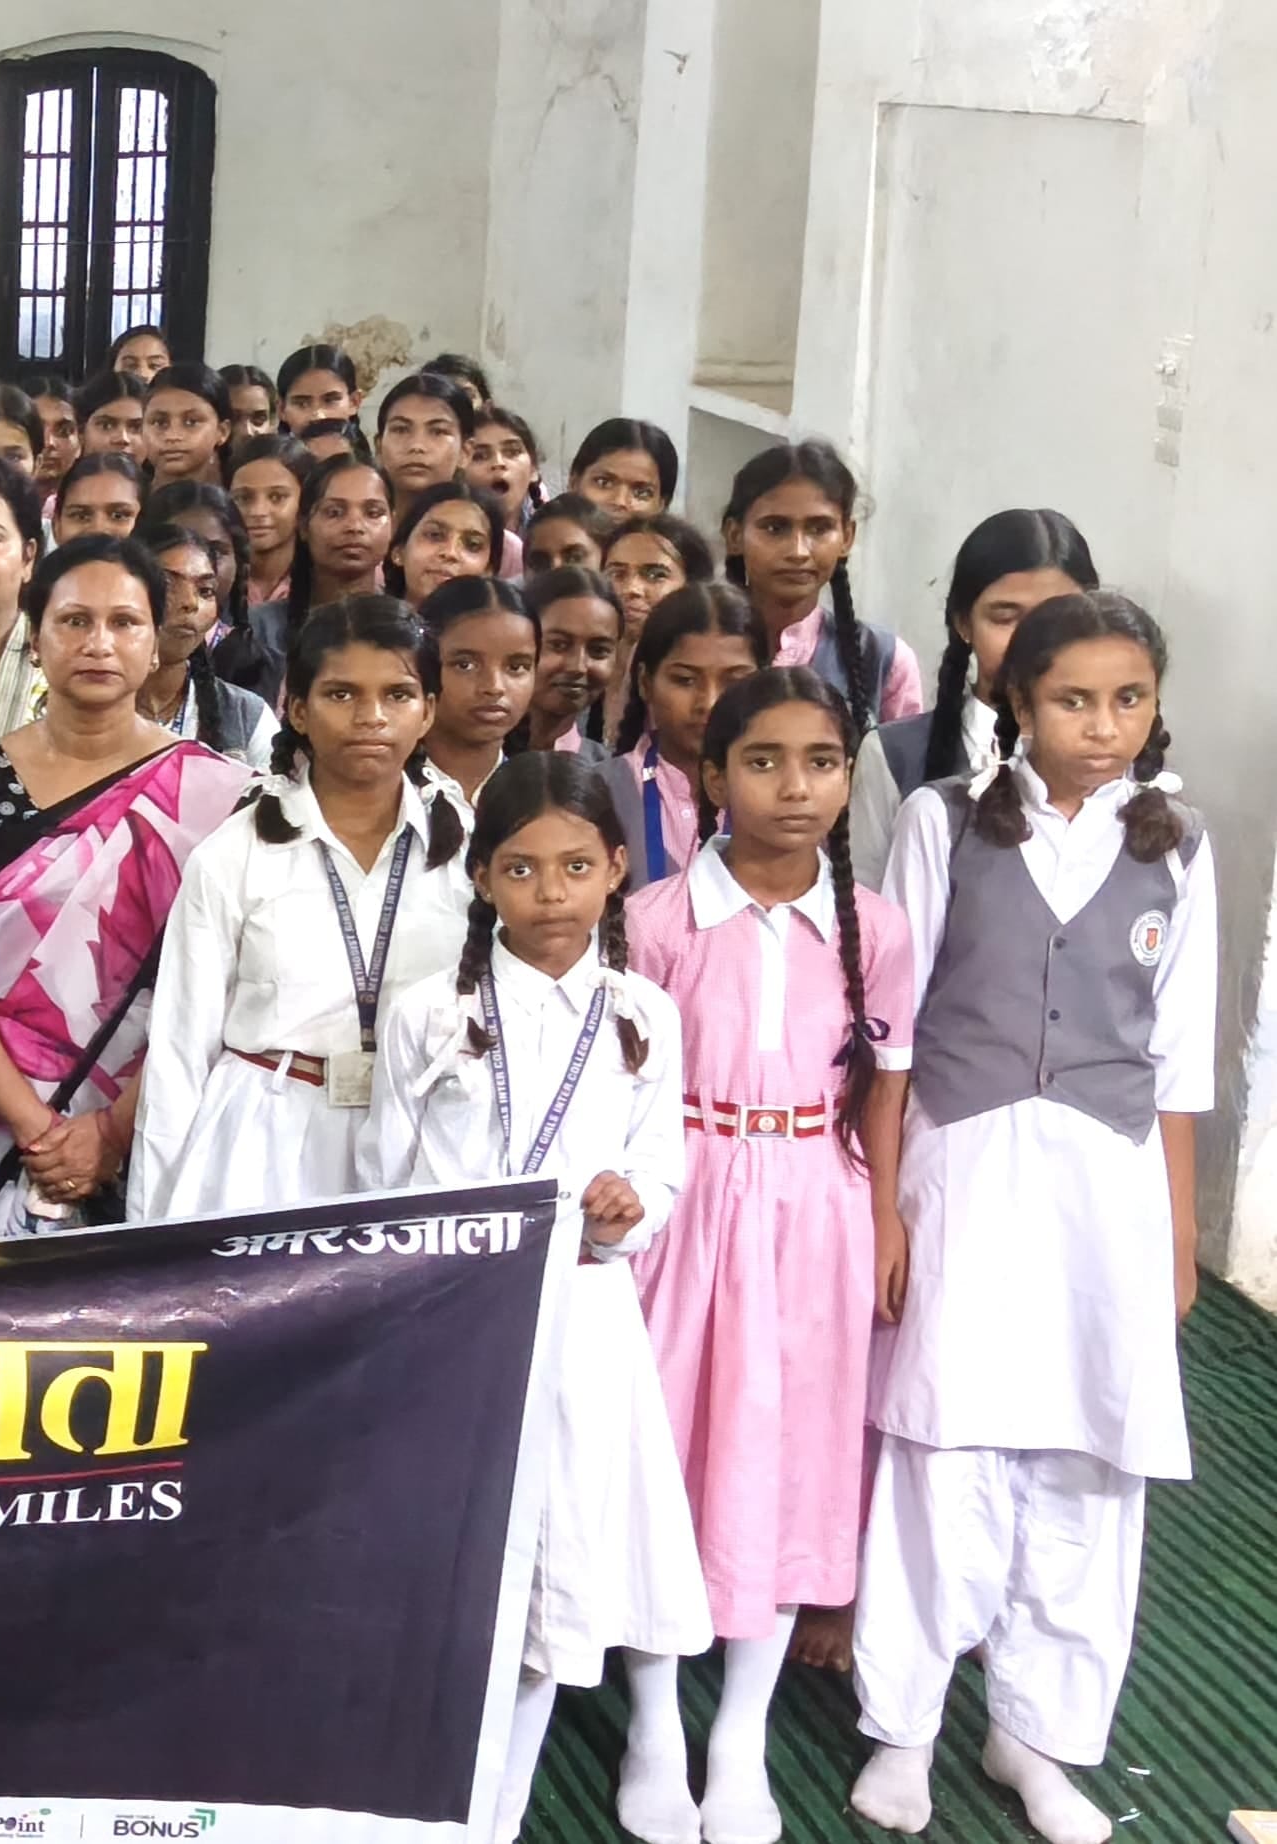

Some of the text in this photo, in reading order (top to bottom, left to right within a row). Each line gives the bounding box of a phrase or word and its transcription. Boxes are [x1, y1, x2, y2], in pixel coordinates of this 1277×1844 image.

[494, 1071, 509, 1104] INTER
[538, 1110, 560, 1144] GIRLS
[552, 1080, 574, 1115] INTER
[113, 1819, 200, 1839] BONUS
